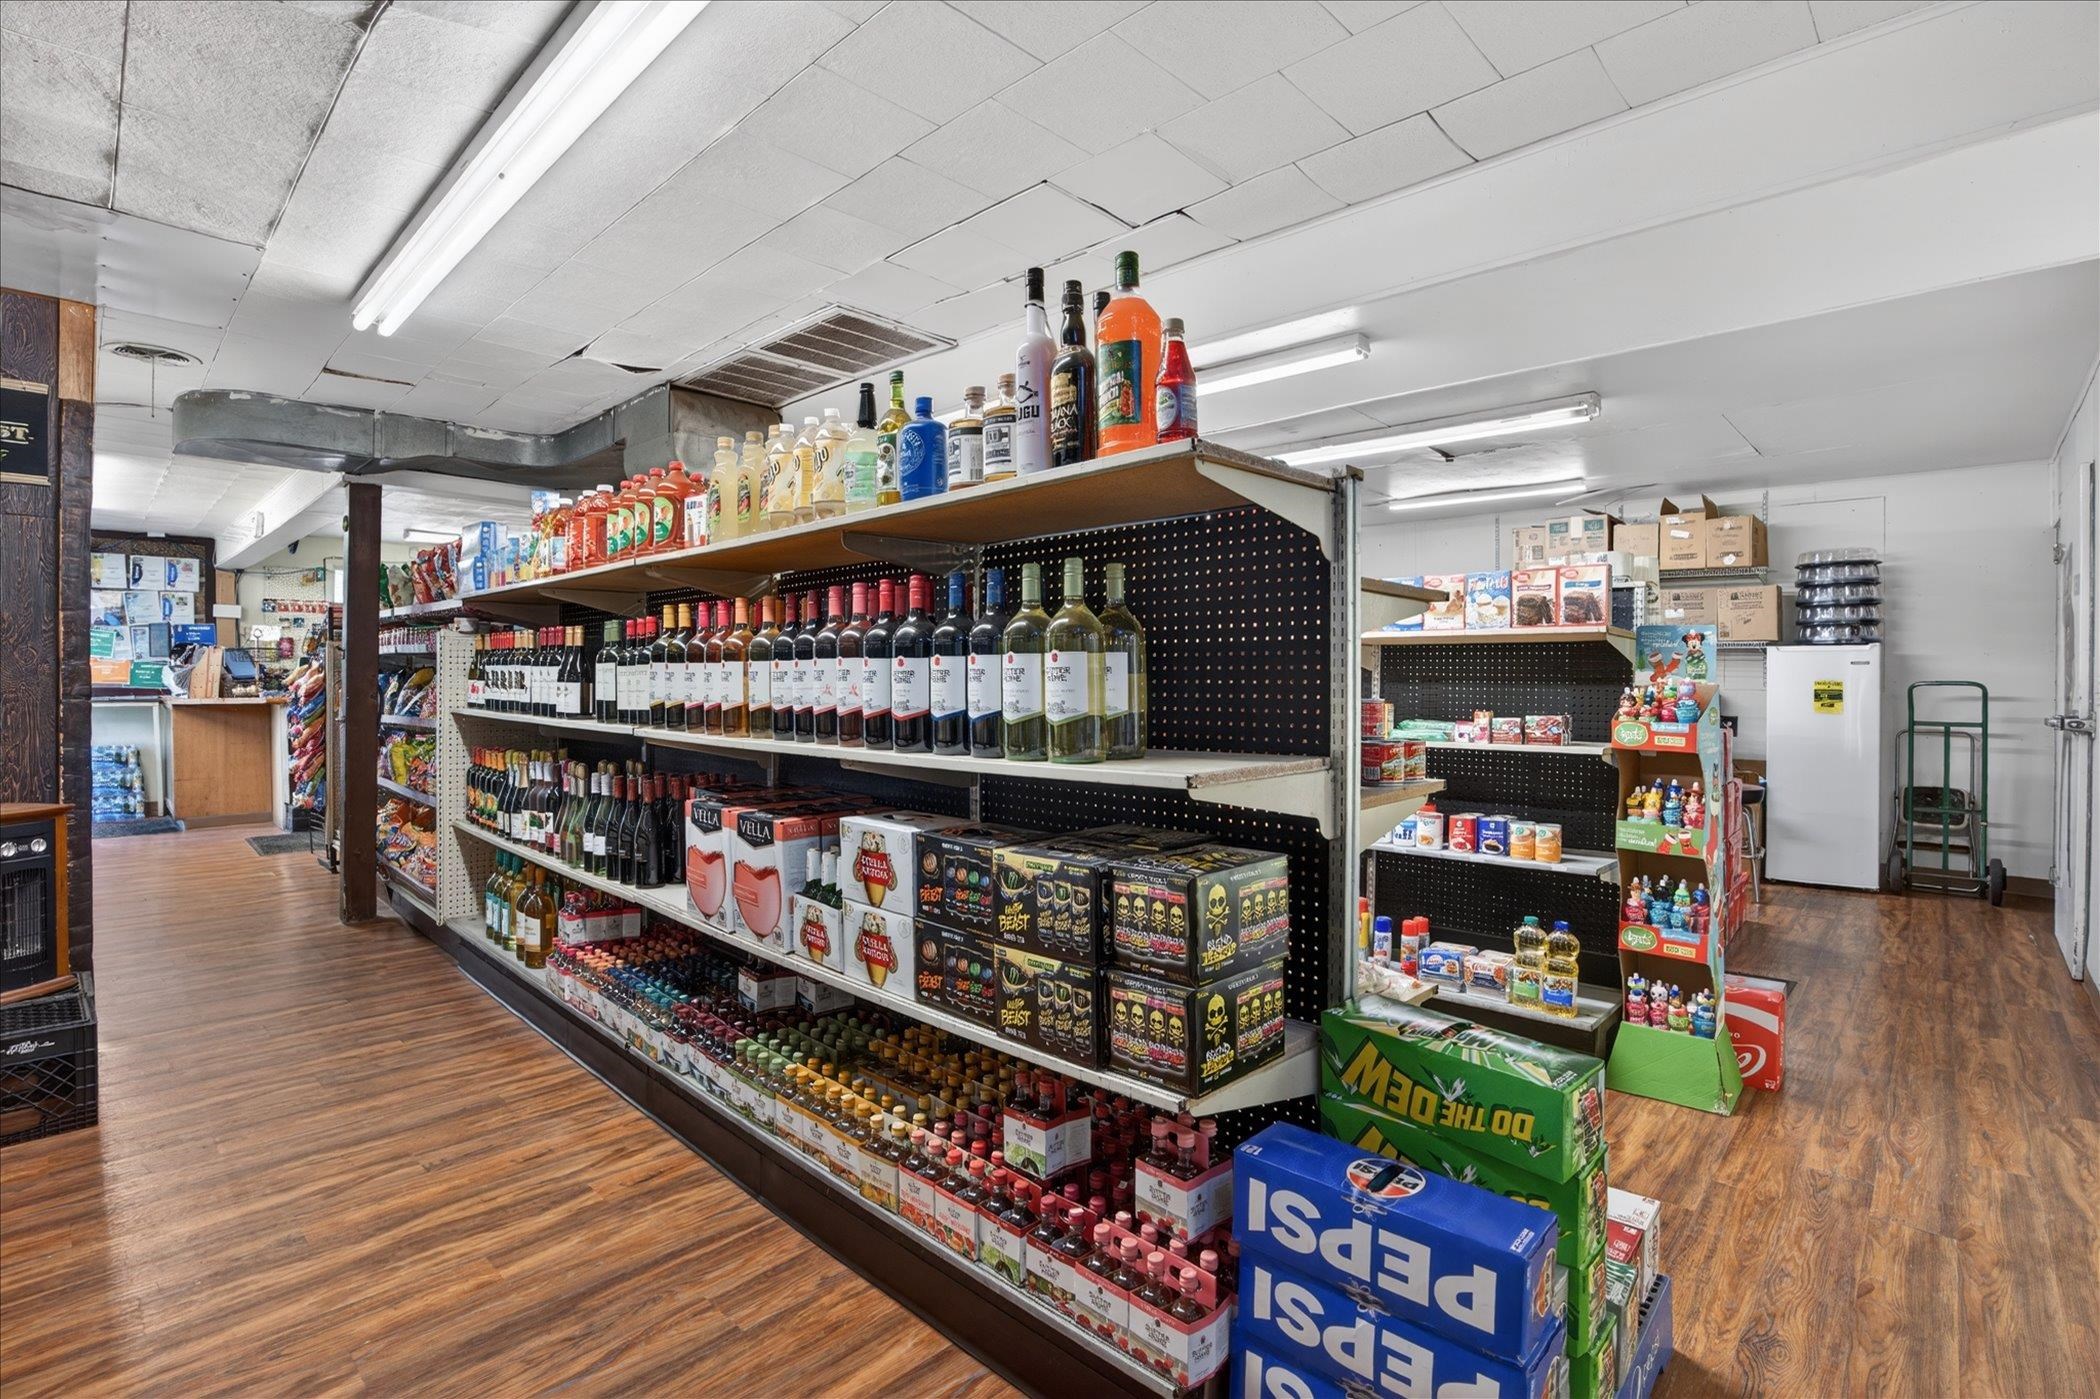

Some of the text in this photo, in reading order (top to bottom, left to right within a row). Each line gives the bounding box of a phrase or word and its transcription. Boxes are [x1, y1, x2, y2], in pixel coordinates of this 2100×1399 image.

[693, 807, 719, 827] VELLA
[740, 819, 771, 840] VELLA
[999, 913, 1031, 932] BEAST
[1001, 1008, 1032, 1027] BEAST
[1341, 1040, 1535, 1143] DO THE DEW
[1353, 1163, 1419, 1190] PESI
[1248, 1177, 1498, 1335] PEPSI
